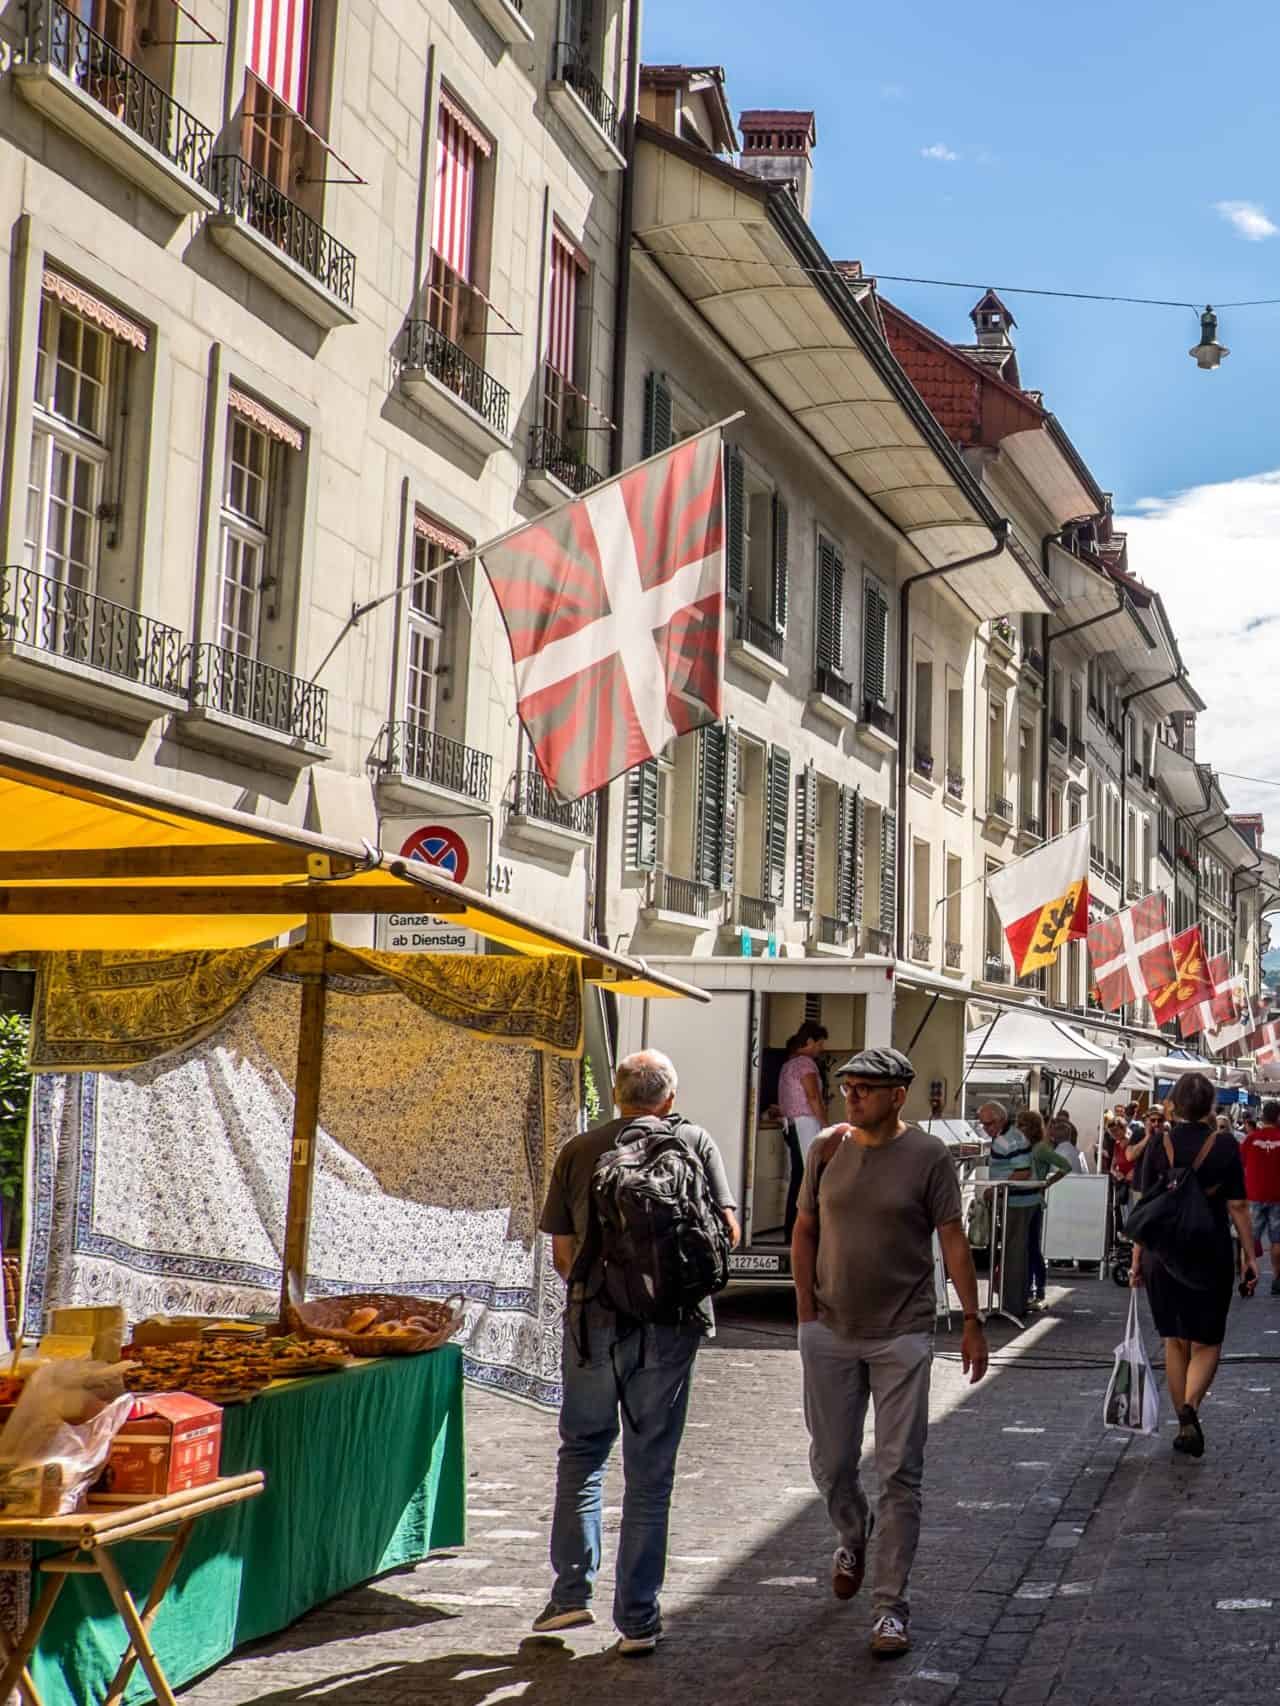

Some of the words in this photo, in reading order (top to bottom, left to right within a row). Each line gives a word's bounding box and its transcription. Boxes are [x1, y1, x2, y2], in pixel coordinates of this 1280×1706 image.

[389, 914, 429, 926] Ganze
[392, 935, 408, 946] ab
[412, 934, 466, 947] Dienstag
